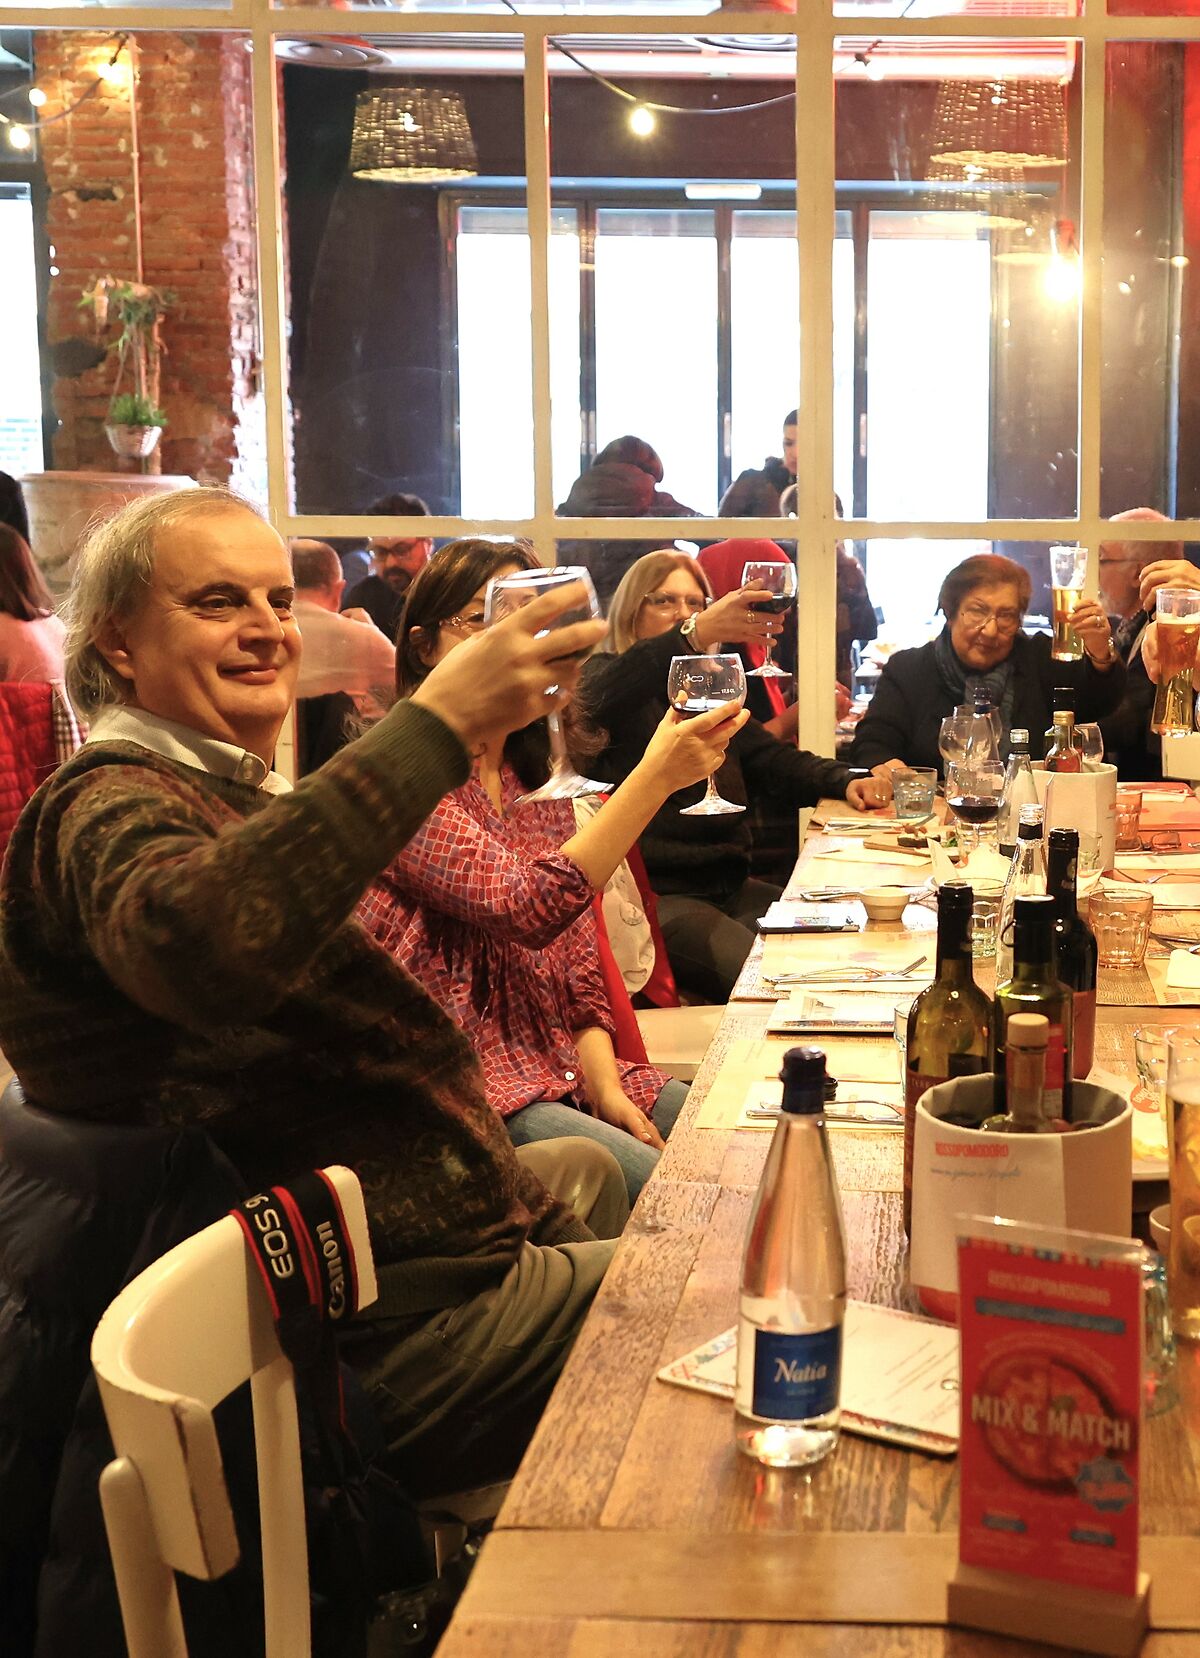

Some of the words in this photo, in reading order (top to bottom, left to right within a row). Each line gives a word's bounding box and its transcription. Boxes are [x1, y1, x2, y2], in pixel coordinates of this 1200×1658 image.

[254, 1208, 295, 1280] EOS
[316, 1220, 346, 1320] Canon
[773, 1357, 828, 1384] Natia
[971, 1394, 1017, 1429] MIX
[1022, 1403, 1040, 1434] &
[1046, 1409, 1131, 1450] MATCH
